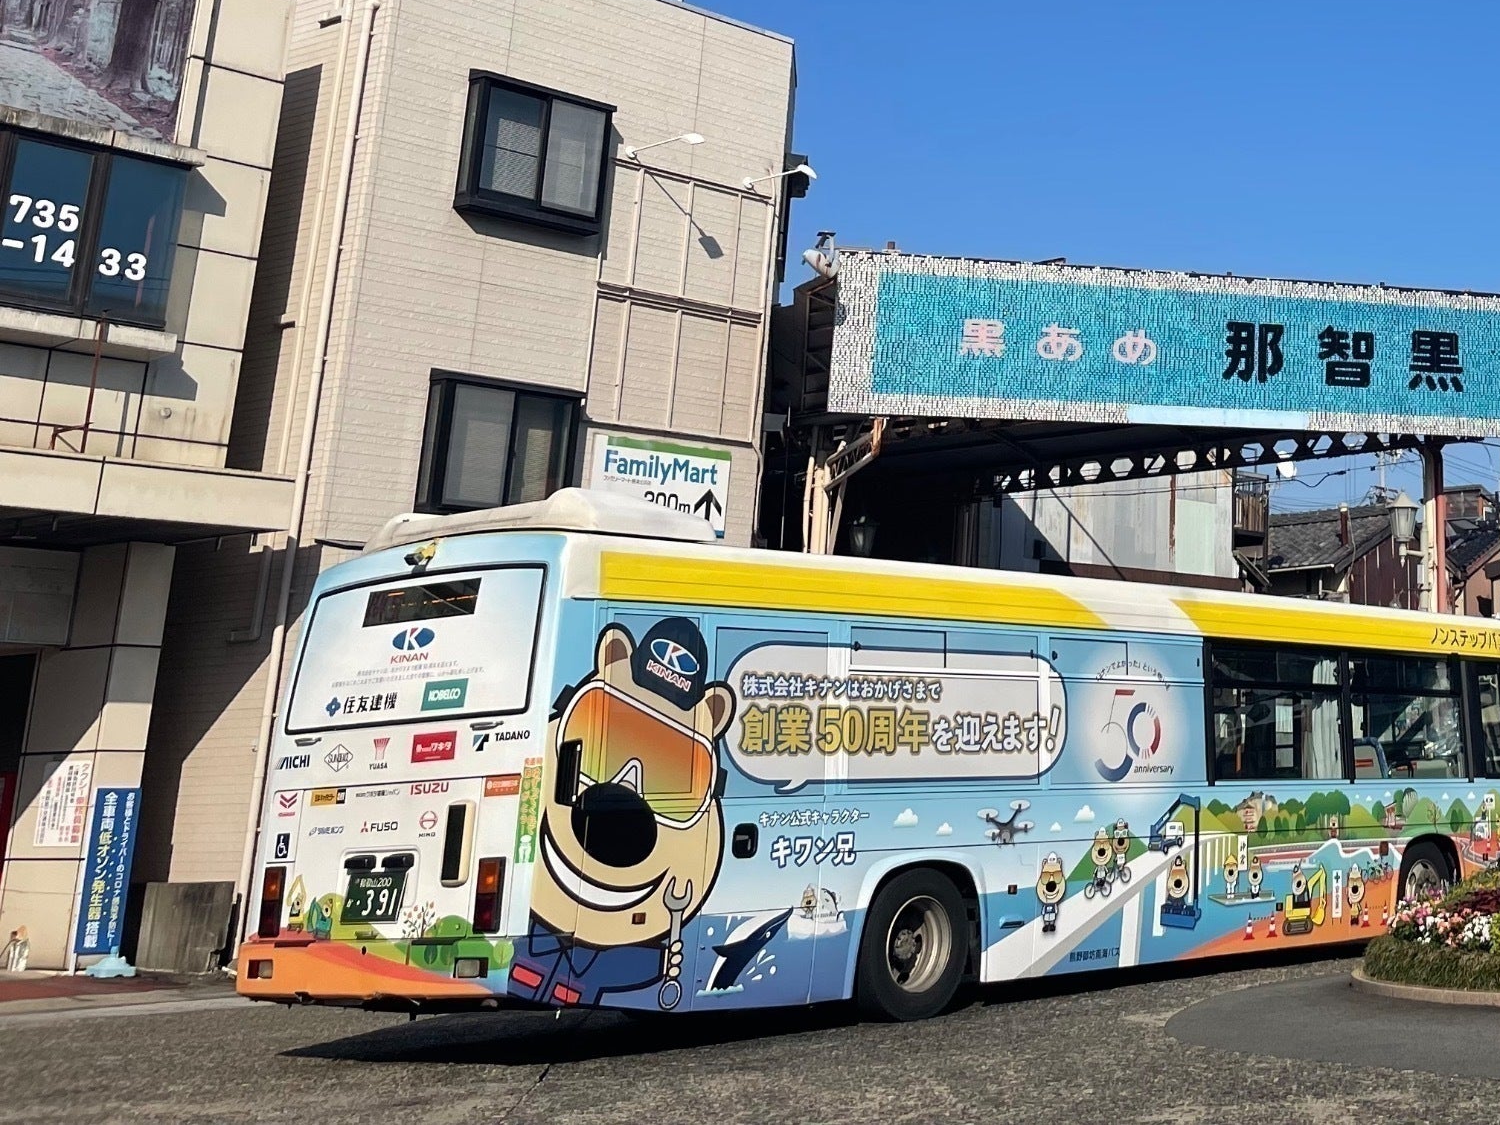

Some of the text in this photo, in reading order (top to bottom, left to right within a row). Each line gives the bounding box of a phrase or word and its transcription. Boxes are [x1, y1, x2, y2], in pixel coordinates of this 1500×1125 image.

[9, 194, 80, 232] 735
[960, 318, 1464, 392] 黒あめ 那智黒
[604, 449, 718, 485] FamilyMart
[390, 652, 429, 664] KINAN
[646, 659, 692, 692] KINAN
[428, 688, 461, 701] KOBELCO
[742, 674, 941, 701] 株式会社キナンはおかげさまで
[343, 692, 398, 714] 住友建機
[495, 730, 531, 741] TADANO
[276, 754, 310, 770] AICHI
[369, 762, 388, 770] YUASA
[1133, 764, 1174, 774] anniversary
[410, 782, 449, 795] ISUZU
[371, 821, 398, 832] FUSO
[759, 808, 870, 827] キナン公式キャラクター
[770, 831, 857, 868] キワン兄
[83, 791, 118, 949] 全車両低オゾン発生器搭載
